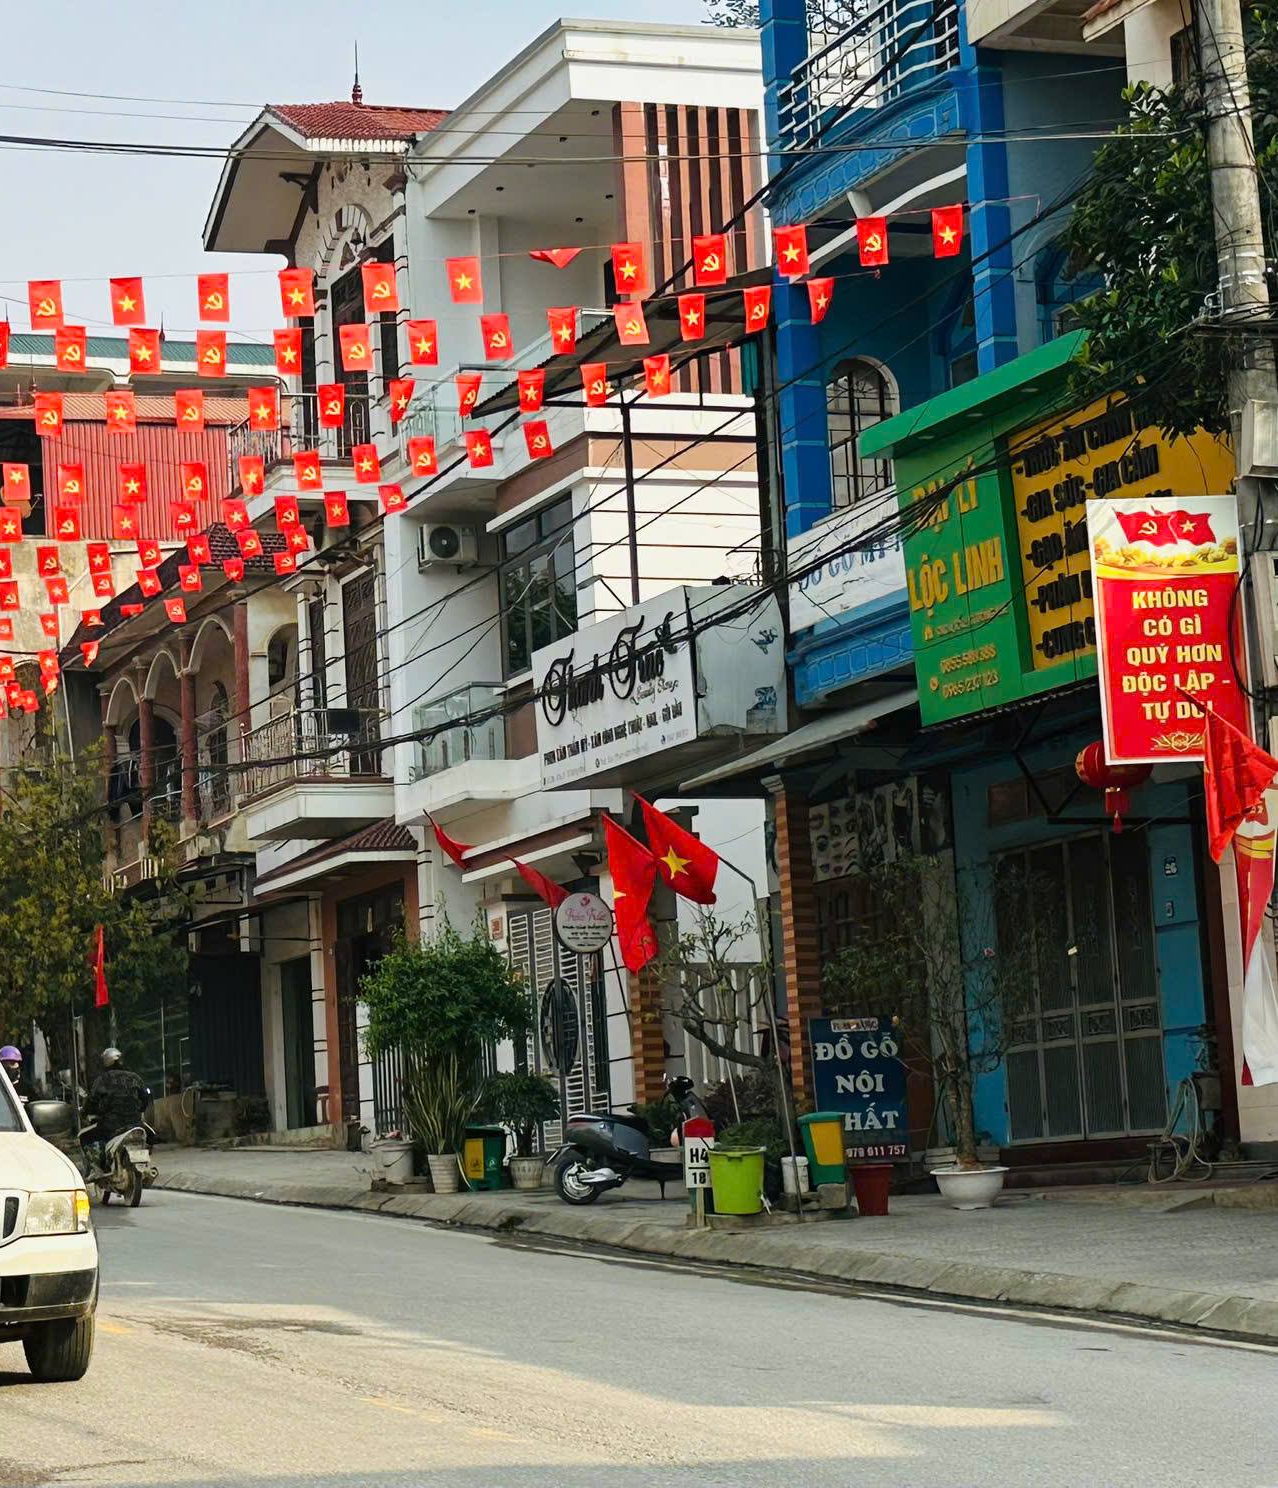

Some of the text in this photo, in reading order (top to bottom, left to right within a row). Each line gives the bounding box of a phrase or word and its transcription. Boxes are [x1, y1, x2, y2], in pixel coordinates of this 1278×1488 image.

[908, 554, 948, 616] LỘC
[953, 537, 1004, 596] LINH
[1133, 587, 1209, 609] KHÔNG
[1143, 613, 1202, 637] CÓ GÌ
[1127, 643, 1222, 666] QUÝ HƠN
[1122, 672, 1167, 696] ĐỘC
[1173, 669, 1215, 694] LẬP
[1142, 700, 1171, 724] TỰ
[815, 1032, 899, 1061] ĐỒ GỖ
[835, 1069, 884, 1098] NỘI
[844, 1102, 899, 1131] HẤT
